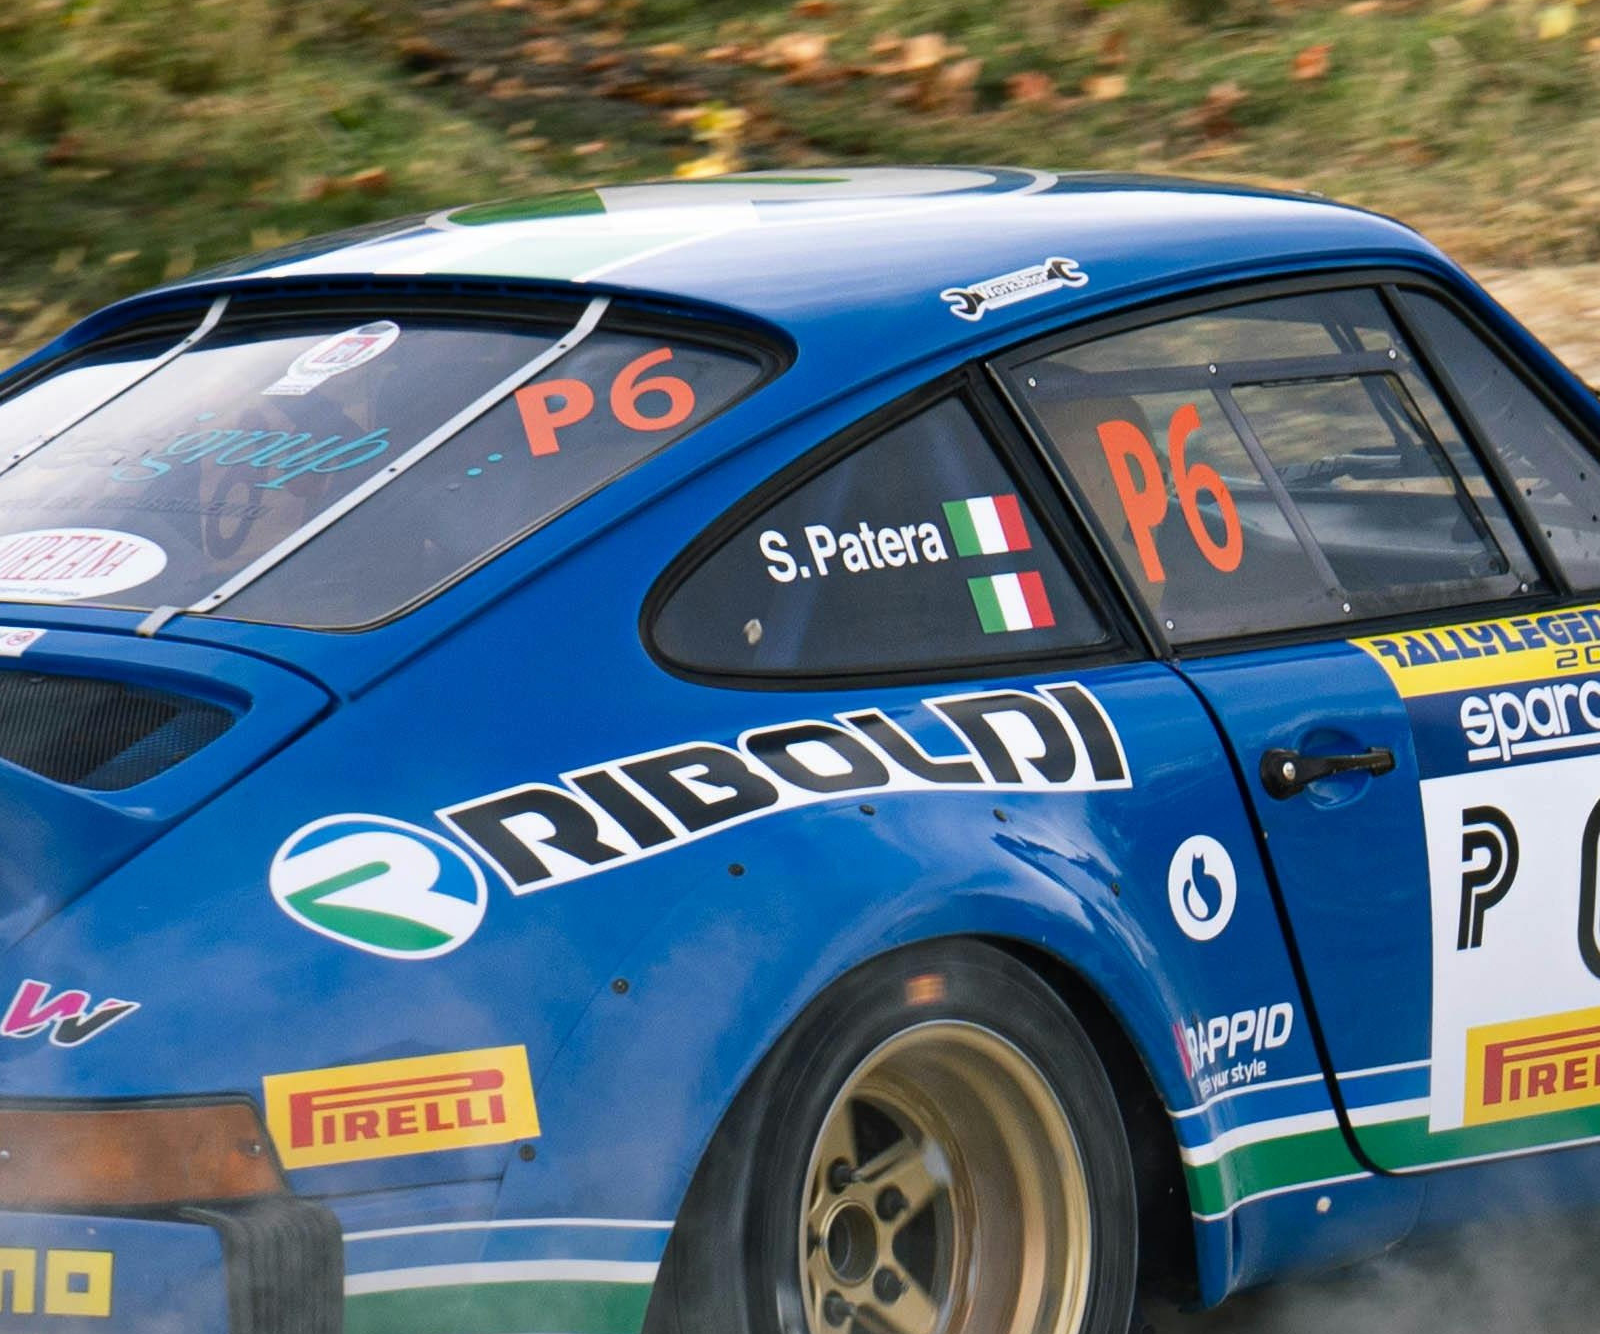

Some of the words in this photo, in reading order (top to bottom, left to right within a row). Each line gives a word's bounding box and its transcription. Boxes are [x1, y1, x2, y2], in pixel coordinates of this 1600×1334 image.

[514, 346, 696, 458] P6
[1096, 403, 1243, 583] P6
[759, 520, 949, 583] S.Patera
[448, 684, 1128, 889] RIBOLDI
[1457, 804, 1520, 951] P
[289, 1068, 506, 1149] PIRELLI
[1231, 1059, 1267, 1084] style
